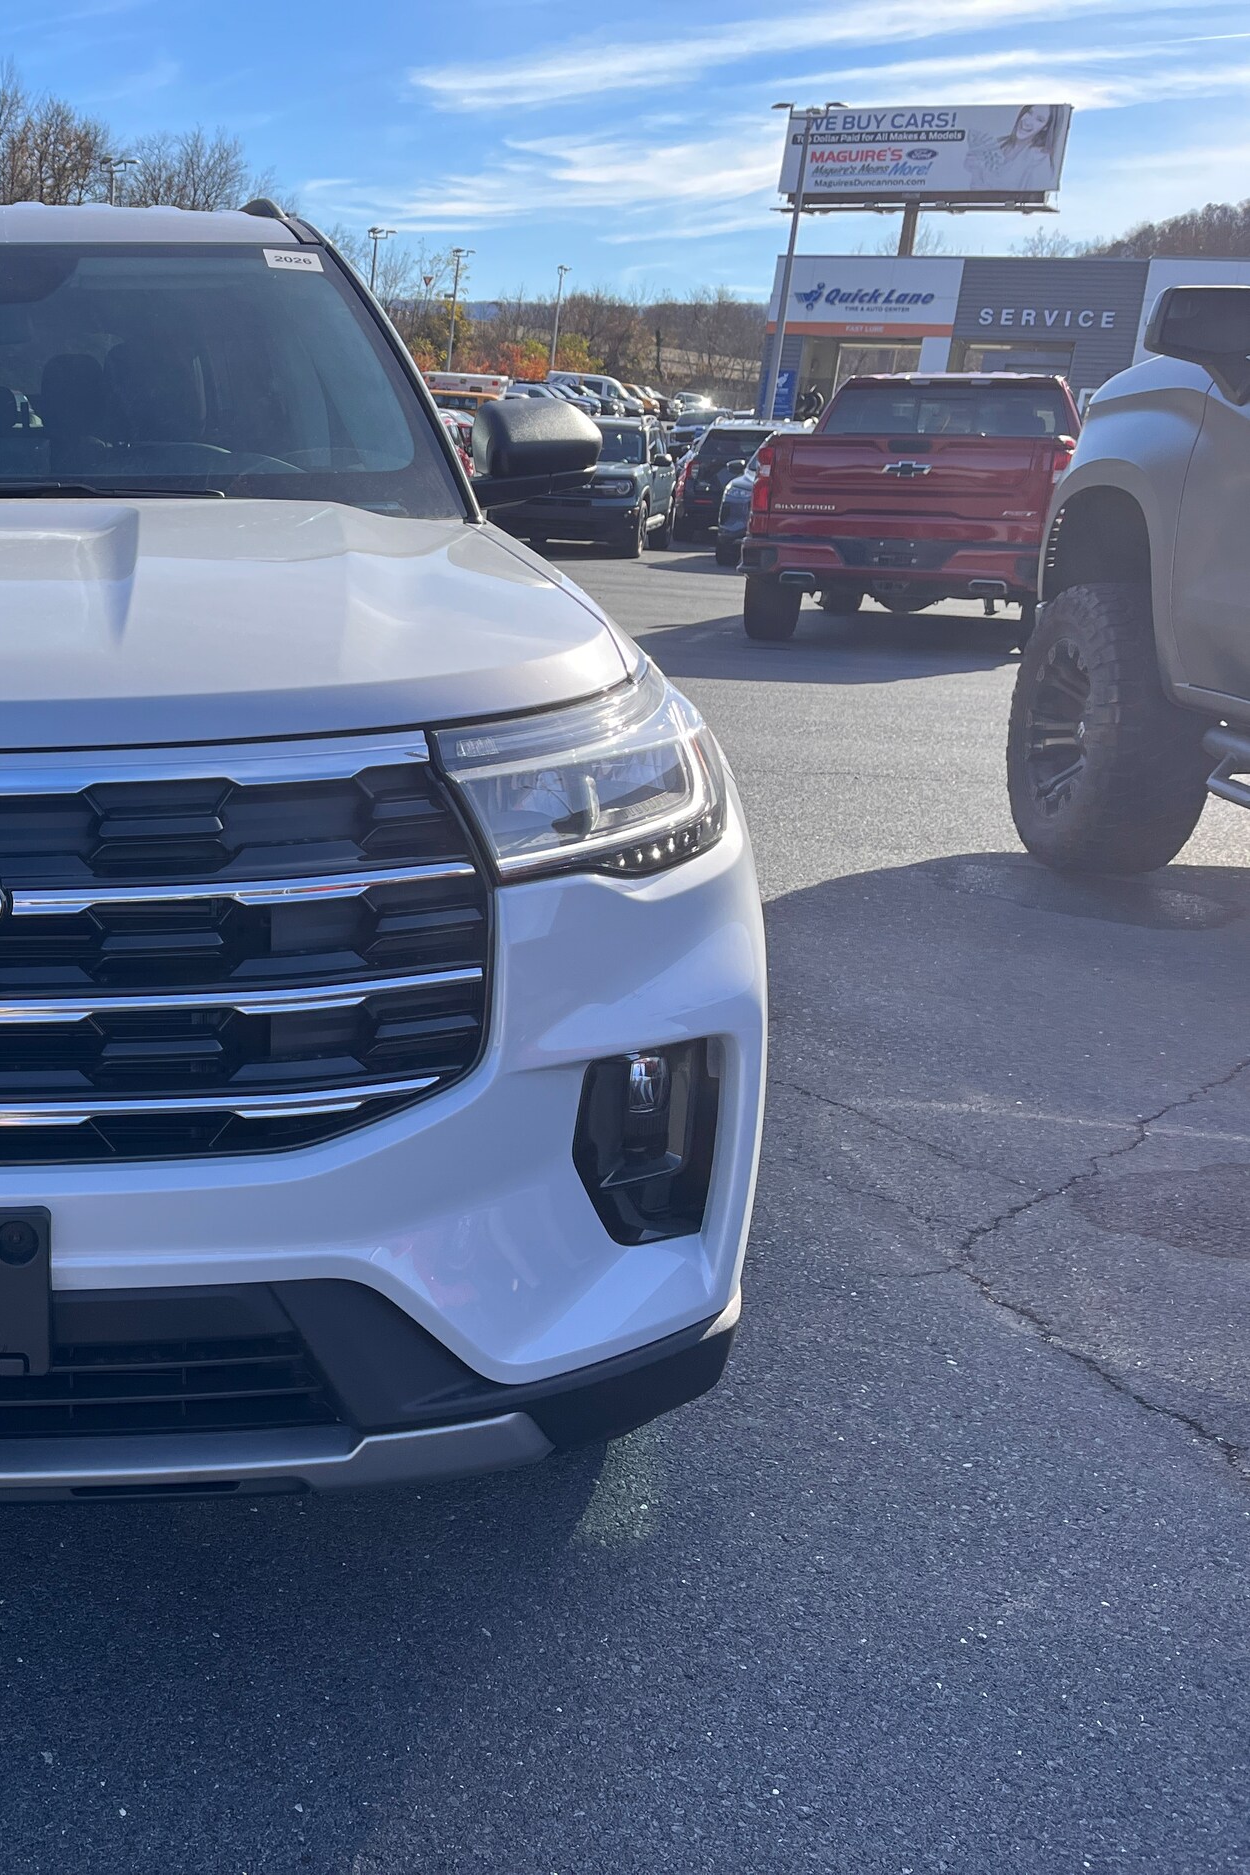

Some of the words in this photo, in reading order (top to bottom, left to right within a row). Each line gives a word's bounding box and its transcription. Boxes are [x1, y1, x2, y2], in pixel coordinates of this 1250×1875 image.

[842, 114, 887, 131] BUY
[890, 112, 958, 129] CARS!
[813, 133, 839, 143] Dollar
[840, 133, 860, 142] Paid
[861, 133, 874, 142] for
[875, 132, 888, 141] All
[889, 132, 919, 141] Makes
[919, 131, 927, 140] &
[928, 131, 963, 140] Models
[810, 147, 903, 163] MAGUIRE'S
[811, 164, 857, 177] Maguire's
[857, 163, 890, 175] Means
[889, 161, 933, 176] More!
[814, 178, 926, 189] MaguiresDuncannon.com
[273, 255, 312, 265] 2026
[825, 288, 883, 306] Quick
[882, 289, 935, 306] Lane
[978, 308, 1116, 328] SERVICE
[845, 325, 864, 333] FAST
[865, 325, 885, 333] LUBE
[774, 503, 835, 511] SILVERADO
